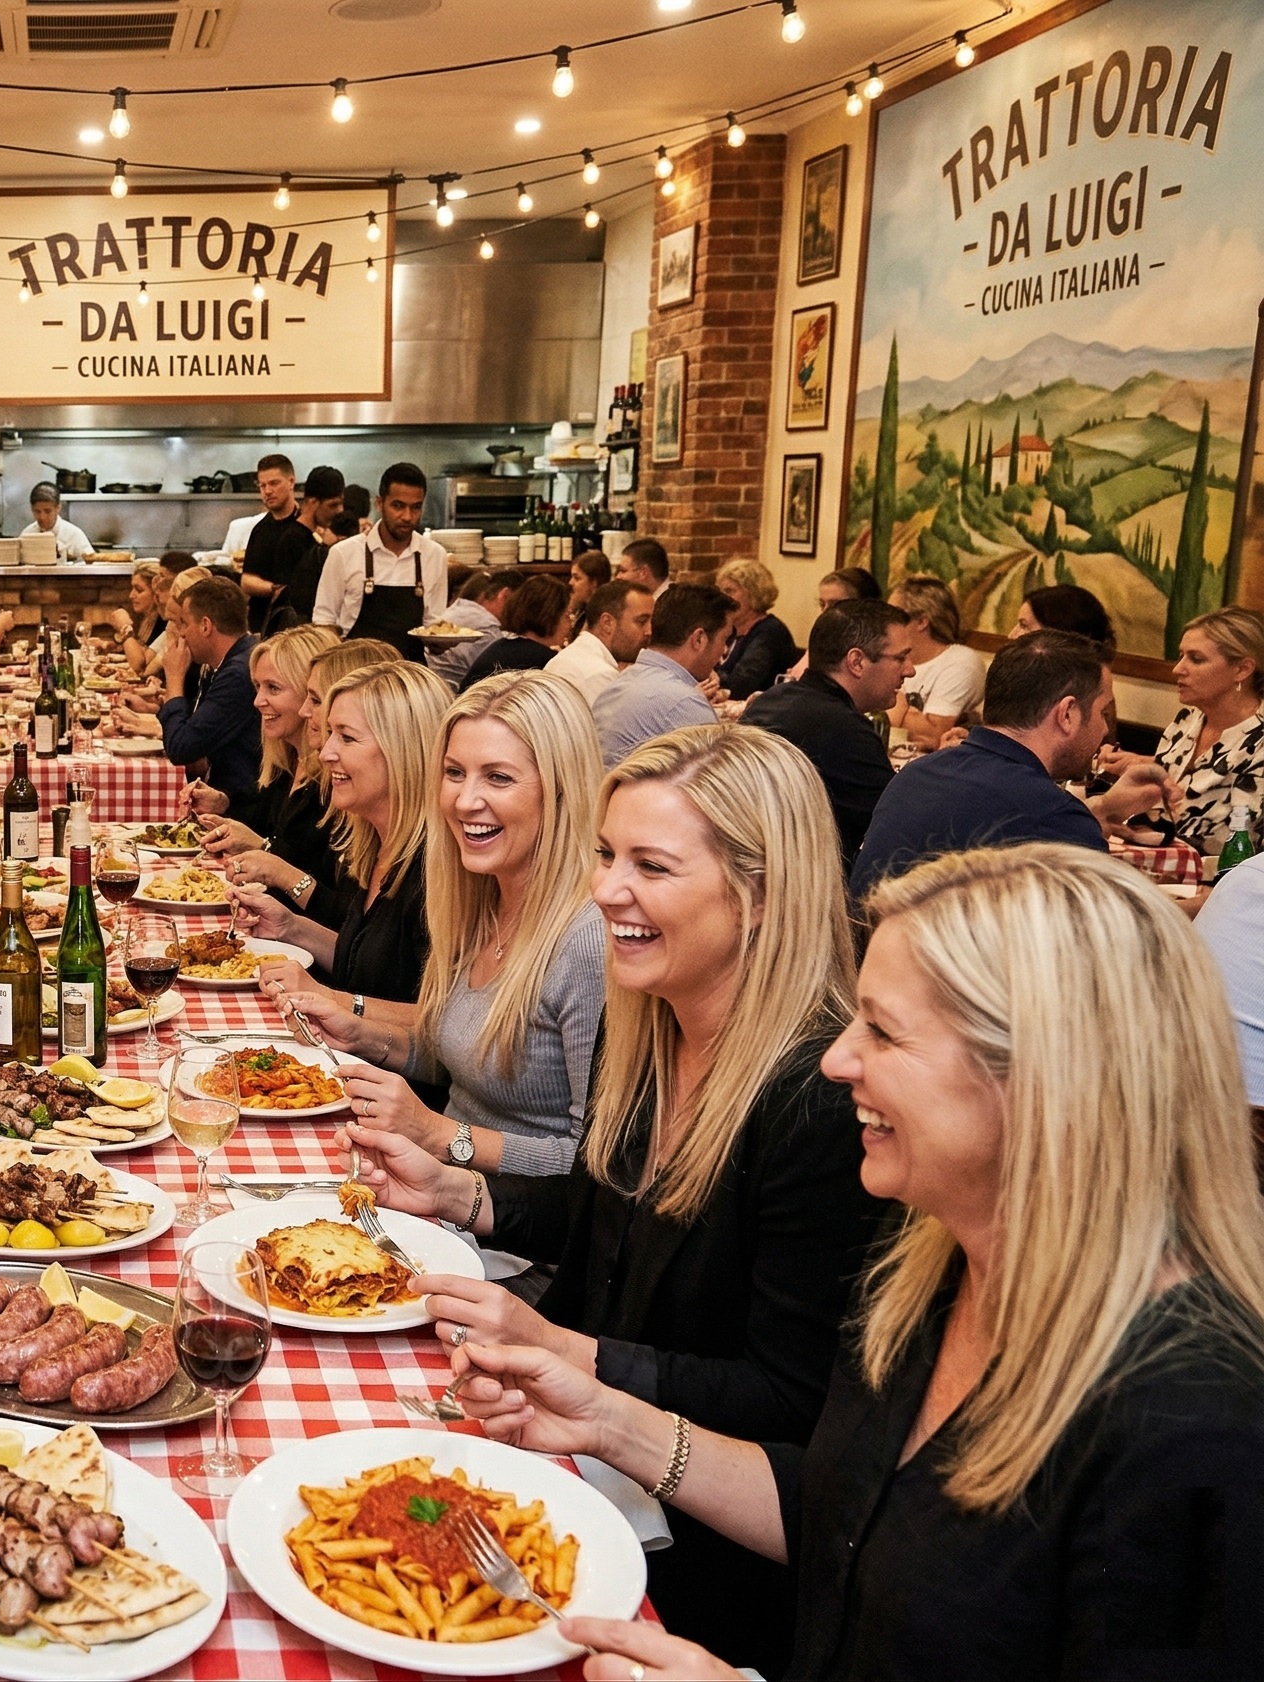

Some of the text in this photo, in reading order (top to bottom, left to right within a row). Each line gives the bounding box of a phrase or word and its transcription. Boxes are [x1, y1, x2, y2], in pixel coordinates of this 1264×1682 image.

[941, 45, 1233, 222] TRATTORIA
[987, 165, 1149, 267] DA LUIGI
[8, 216, 334, 298] TRATTORIA
[981, 252, 1140, 316] CUCINA ITALIANA
[80, 299, 269, 342] DA LUIGI
[77, 354, 271, 378] CUCINA ITALIANA
